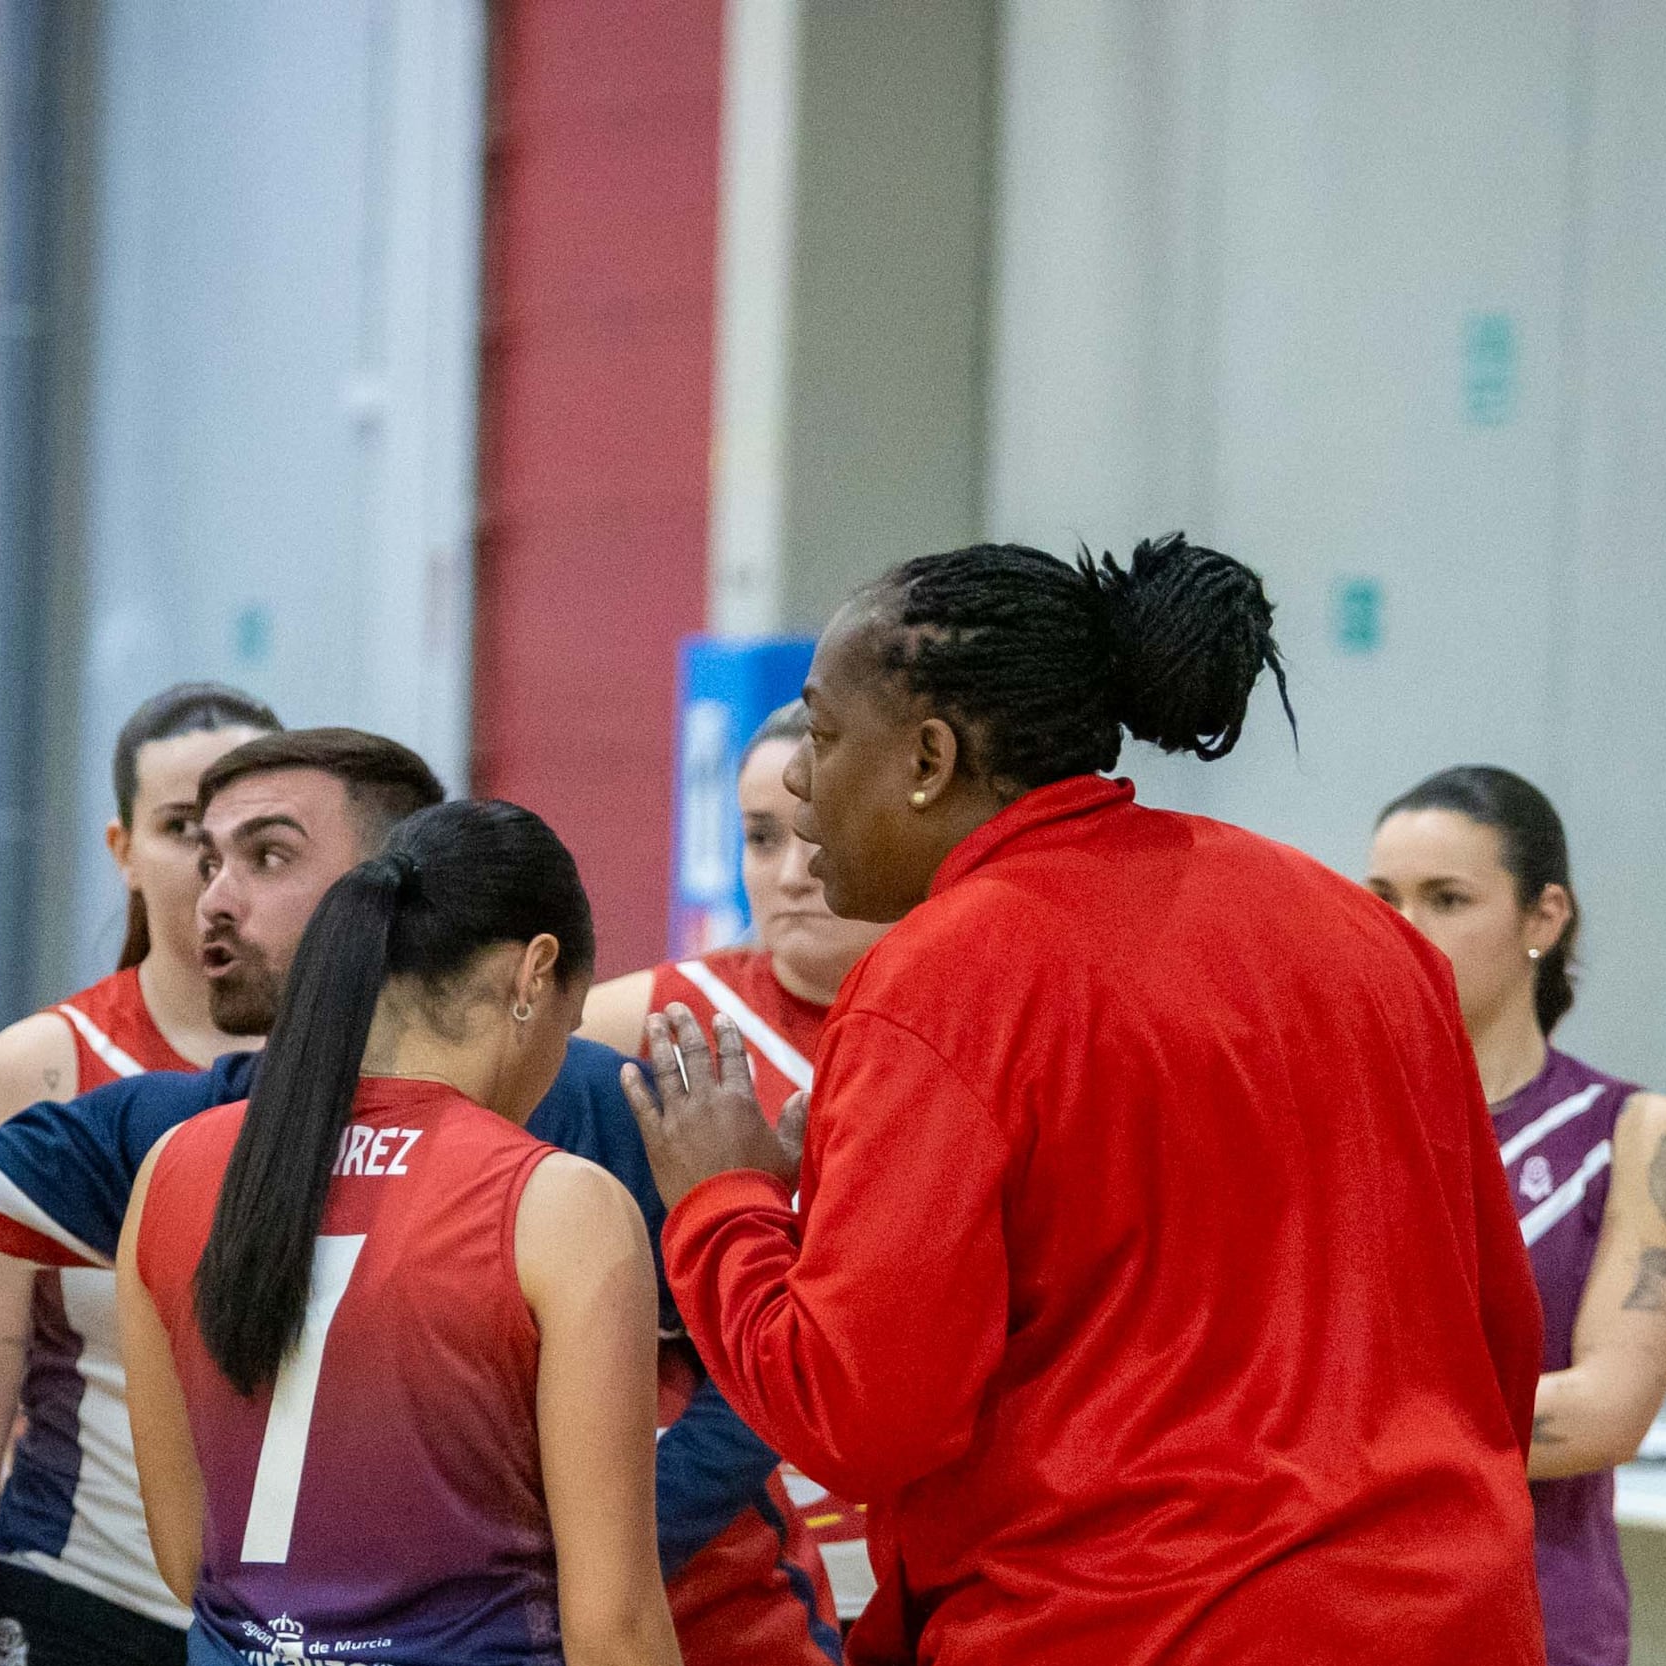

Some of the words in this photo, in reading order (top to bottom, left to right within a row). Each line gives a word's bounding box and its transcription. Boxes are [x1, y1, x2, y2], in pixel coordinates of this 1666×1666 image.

[332, 1124, 424, 1177] IREZ
[240, 1234, 368, 1564] 7
[238, 1619, 274, 1647] egión
[308, 1641, 330, 1655] de
[334, 1637, 393, 1653] Murcia
